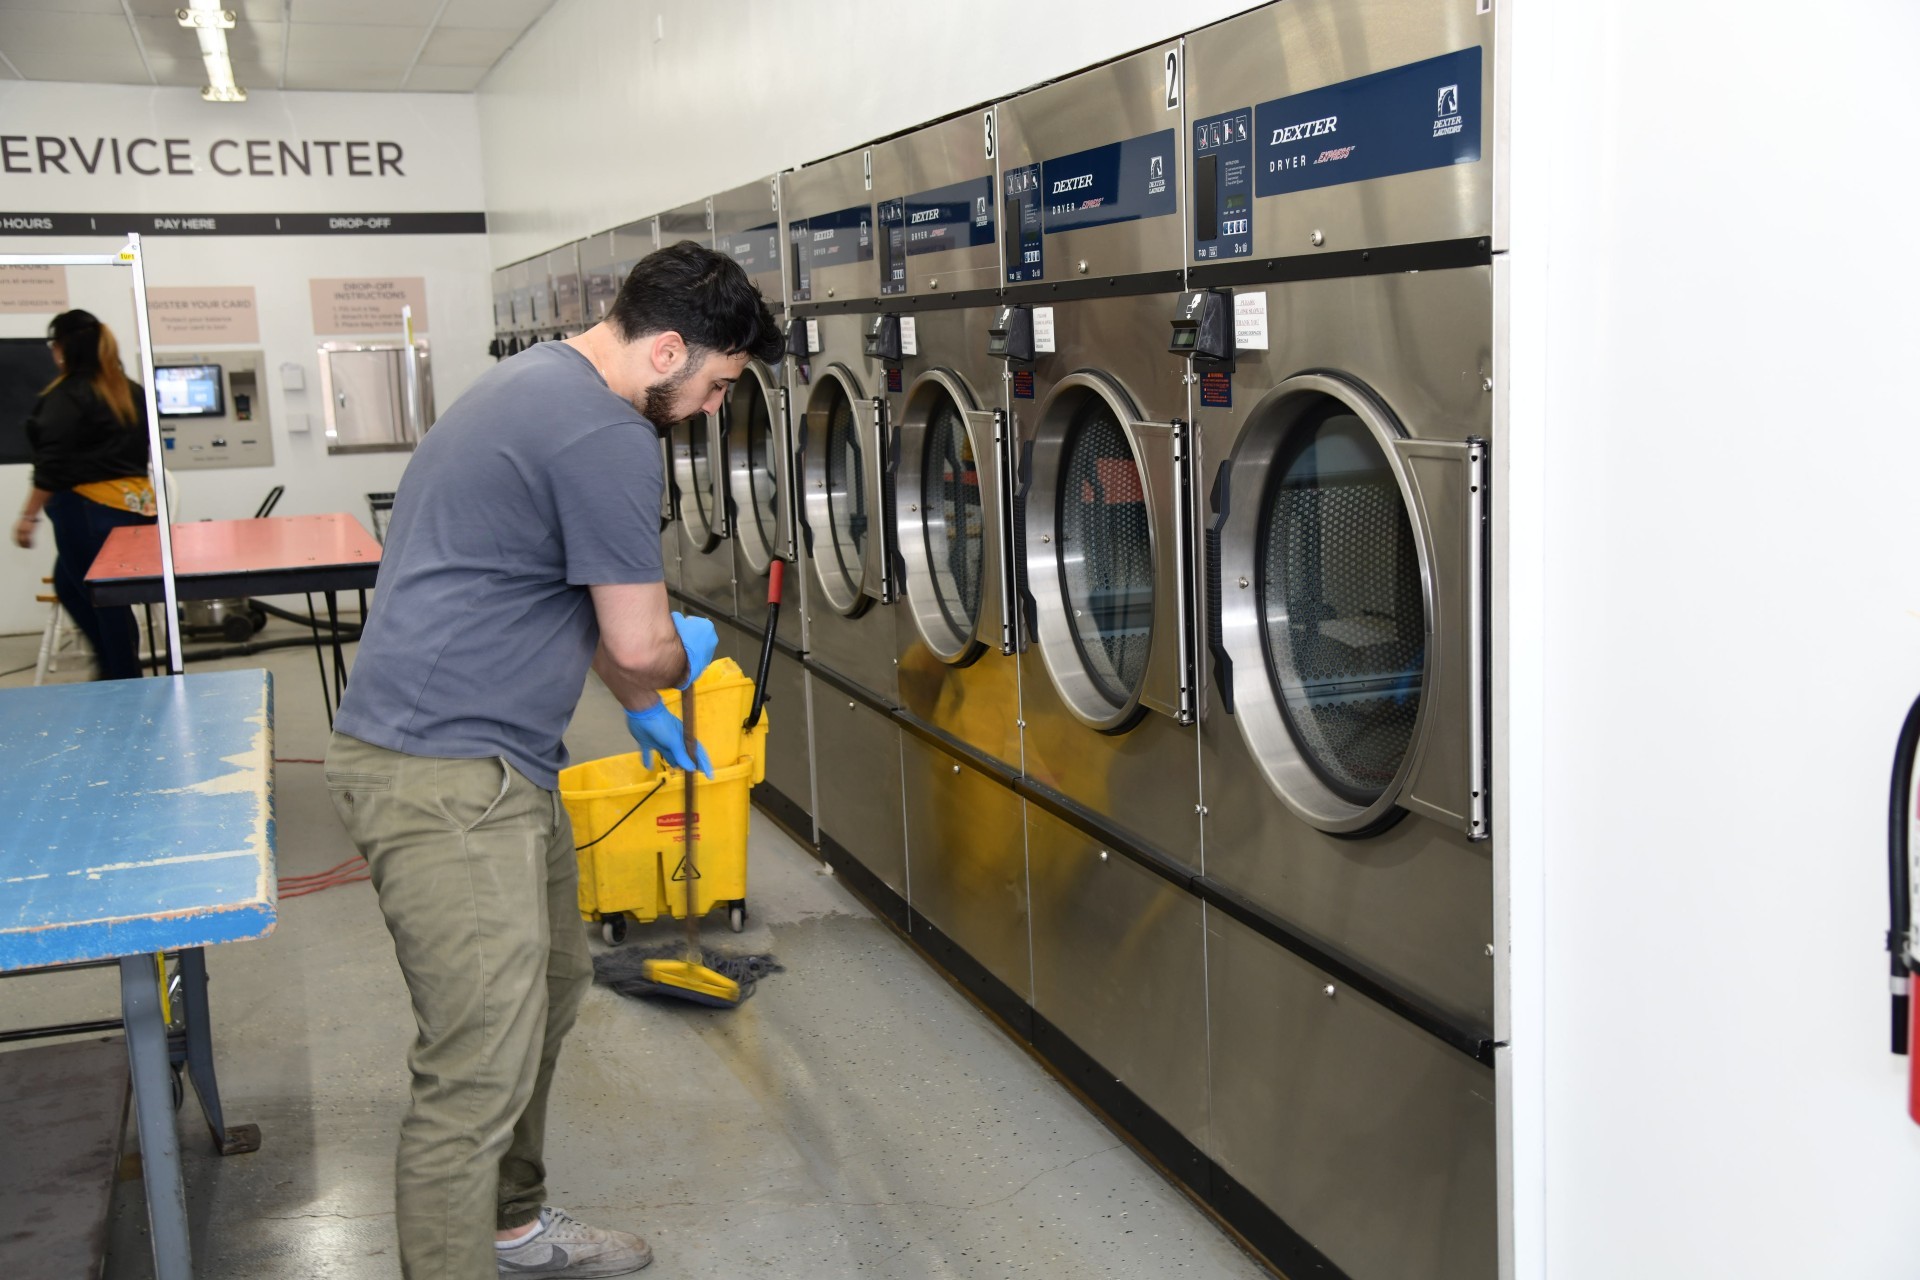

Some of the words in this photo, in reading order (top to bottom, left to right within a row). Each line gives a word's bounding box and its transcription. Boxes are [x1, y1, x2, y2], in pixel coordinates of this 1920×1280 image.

[1167, 53, 1178, 108] 2
[1433, 116, 1462, 129] DEXTER
[986, 114, 993, 157] 3
[1270, 116, 1338, 145] DEXTER
[1433, 125, 1463, 137] LAUNDRY
[0, 135, 195, 176] ERVICE
[209, 139, 406, 177] CENTER
[1270, 155, 1306, 172] DRYER
[1314, 146, 1354, 164] EXPRESS
[865, 152, 871, 189] 4
[1052, 174, 1093, 194] DEXTER
[1052, 202, 1075, 215] DRYER
[911, 208, 940, 224] DEXTER
[4, 218, 53, 230] HOURS
[154, 218, 180, 230] PAY
[182, 218, 216, 230] HERE
[329, 217, 392, 229] DROP-OFF
[1234, 243, 1239, 253] 3
[343, 282, 393, 291] DROP-OFF
[335, 291, 406, 300] INSTRUCTIONS
[147, 300, 188, 310] EGISTER
[192, 300, 219, 309] YOUR
[221, 299, 252, 309] CARD
